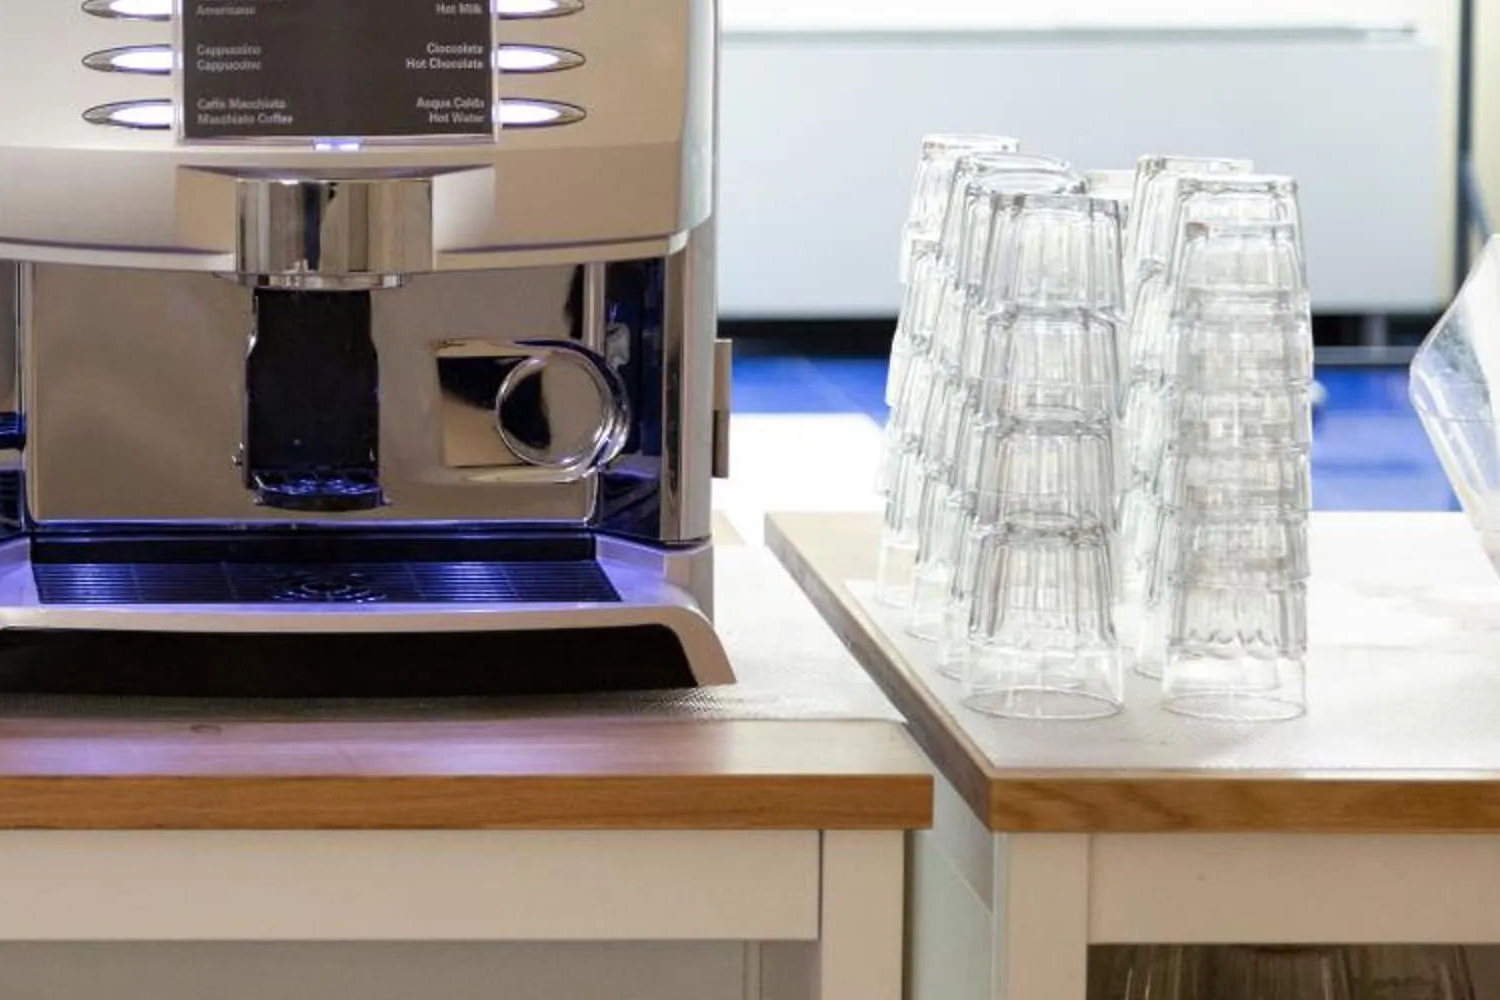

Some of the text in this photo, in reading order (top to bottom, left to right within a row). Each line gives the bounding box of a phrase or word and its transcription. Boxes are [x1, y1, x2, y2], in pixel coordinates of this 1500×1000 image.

[436, 2, 483, 15] Hot Milk
[197, 44, 261, 57] Cappuccino
[197, 59, 261, 73] Cappuccino
[405, 58, 484, 69] Hot Chocolate
[257, 112, 293, 124] Coffee
[429, 111, 485, 123] Hot Water
